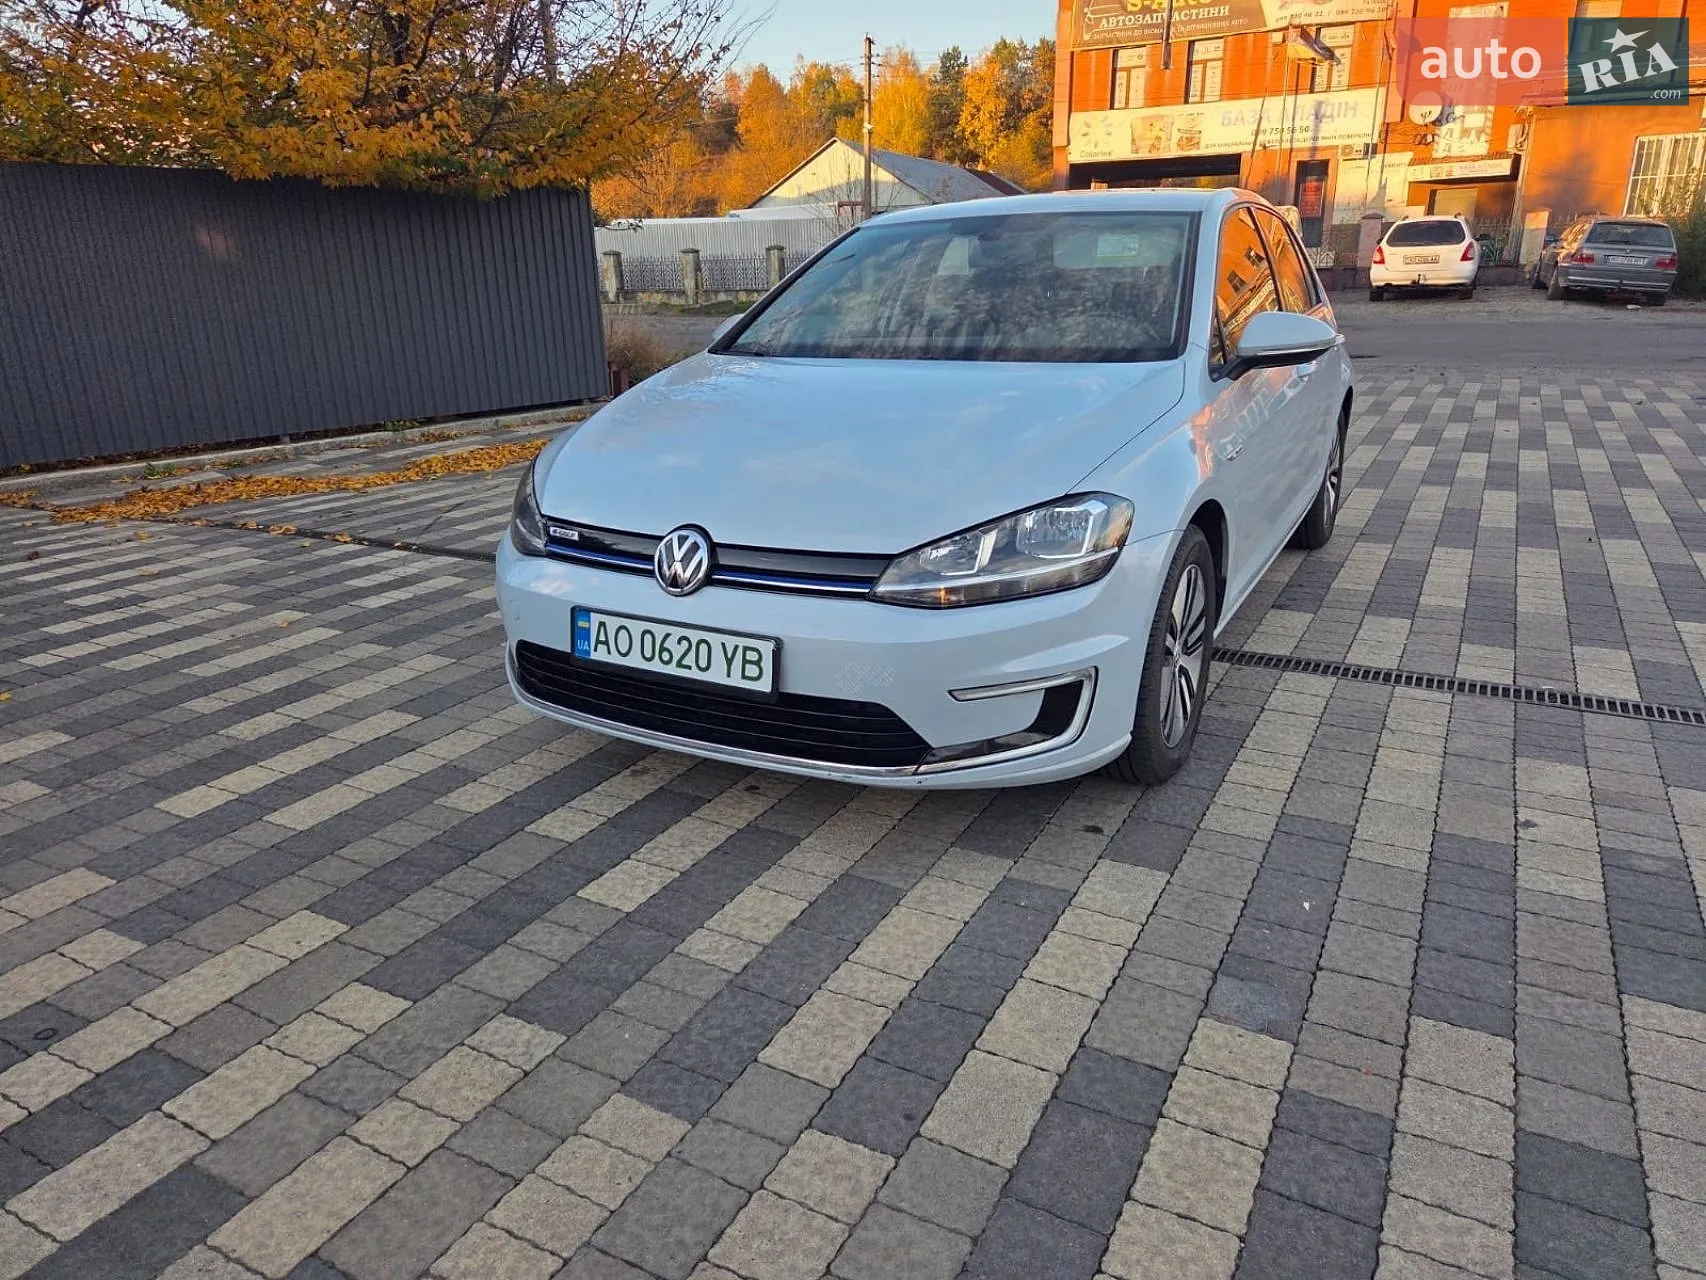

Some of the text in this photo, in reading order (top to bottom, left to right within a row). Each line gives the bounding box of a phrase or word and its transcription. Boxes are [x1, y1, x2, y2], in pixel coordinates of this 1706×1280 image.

[577, 639, 590, 650] UA
[593, 620, 764, 682] AO 0620 YB
